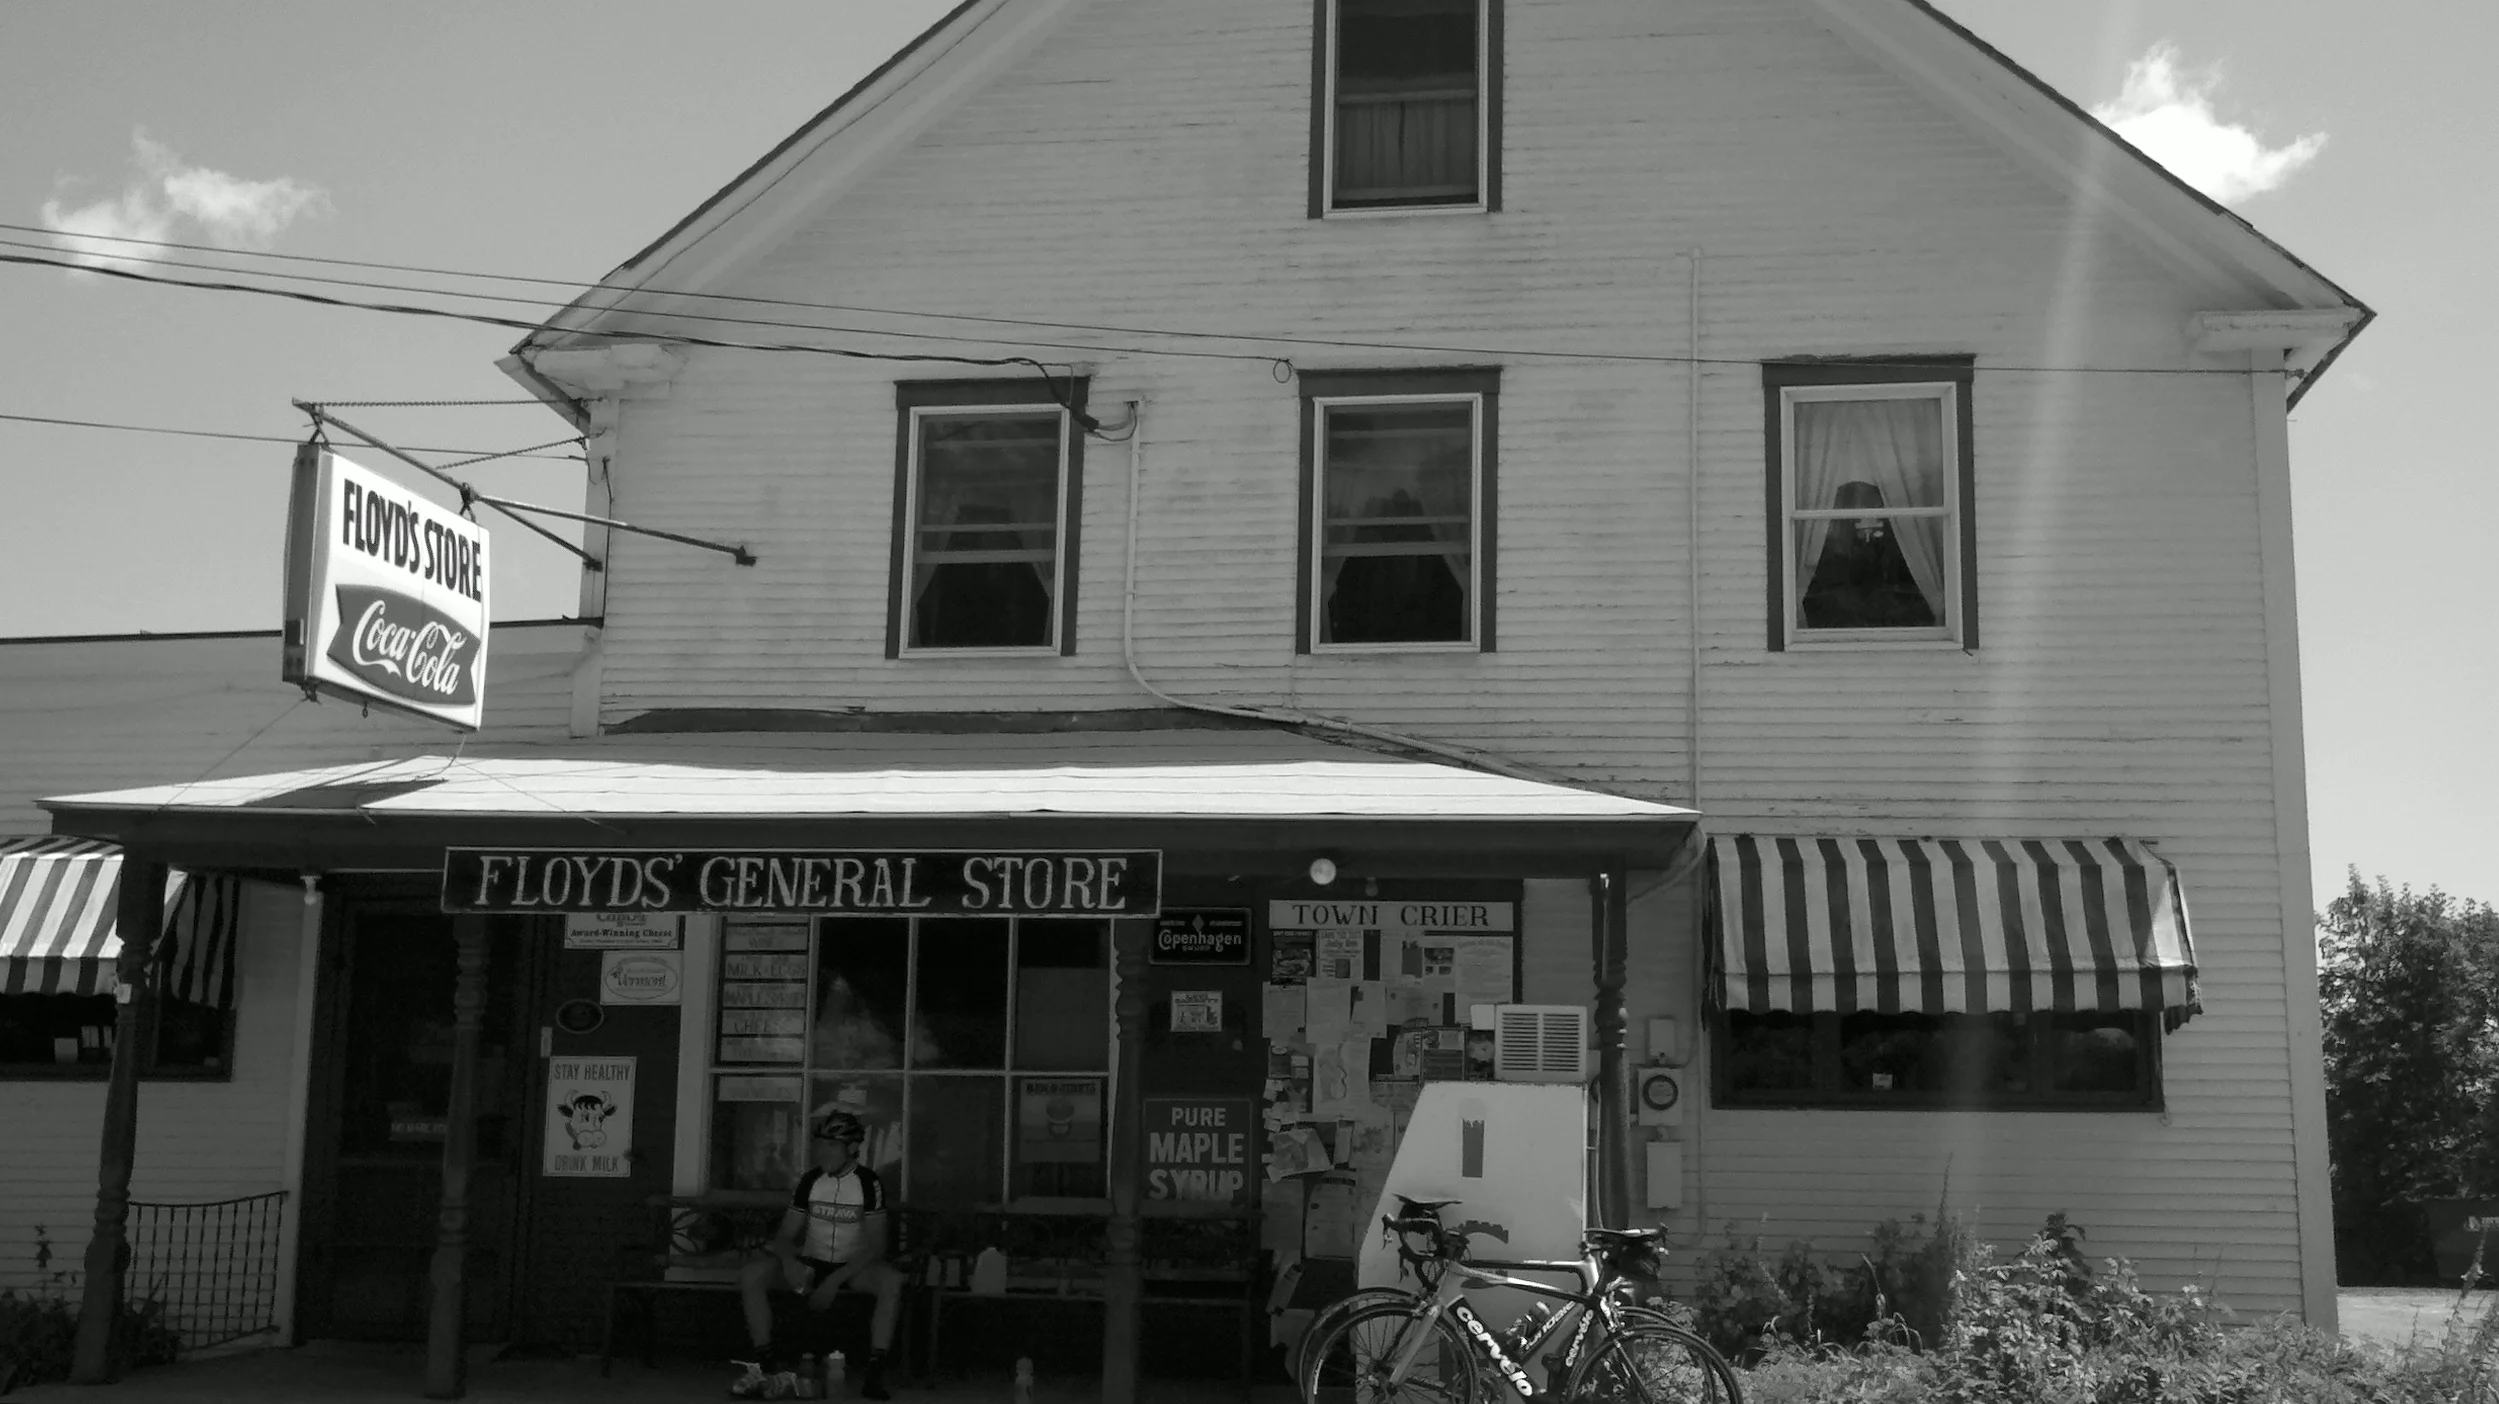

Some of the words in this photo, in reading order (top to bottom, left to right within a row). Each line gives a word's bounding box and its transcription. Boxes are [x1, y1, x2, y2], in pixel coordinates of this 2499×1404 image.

[343, 478, 421, 574] FLOYD'S
[424, 517, 482, 603] STORE
[352, 598, 466, 695] Coca-Cola
[474, 853, 684, 908] FLOYDS'
[700, 856, 932, 908] GENERAL
[962, 857, 1128, 909] STORE
[1292, 904, 1378, 926] TOWN
[1400, 905, 1489, 927] CRIER
[1158, 929, 1242, 952] Copenhagen
[554, 1063, 580, 1081] STAY
[584, 1064, 631, 1081] HEALTHY
[1171, 1107, 1227, 1127] PURE
[1149, 1132, 1245, 1164] MAPLE
[554, 1155, 588, 1172] DRINK
[592, 1155, 620, 1172] MILK
[1148, 1168, 1244, 1201] SYRUP
[812, 1204, 857, 1219] STRAVA
